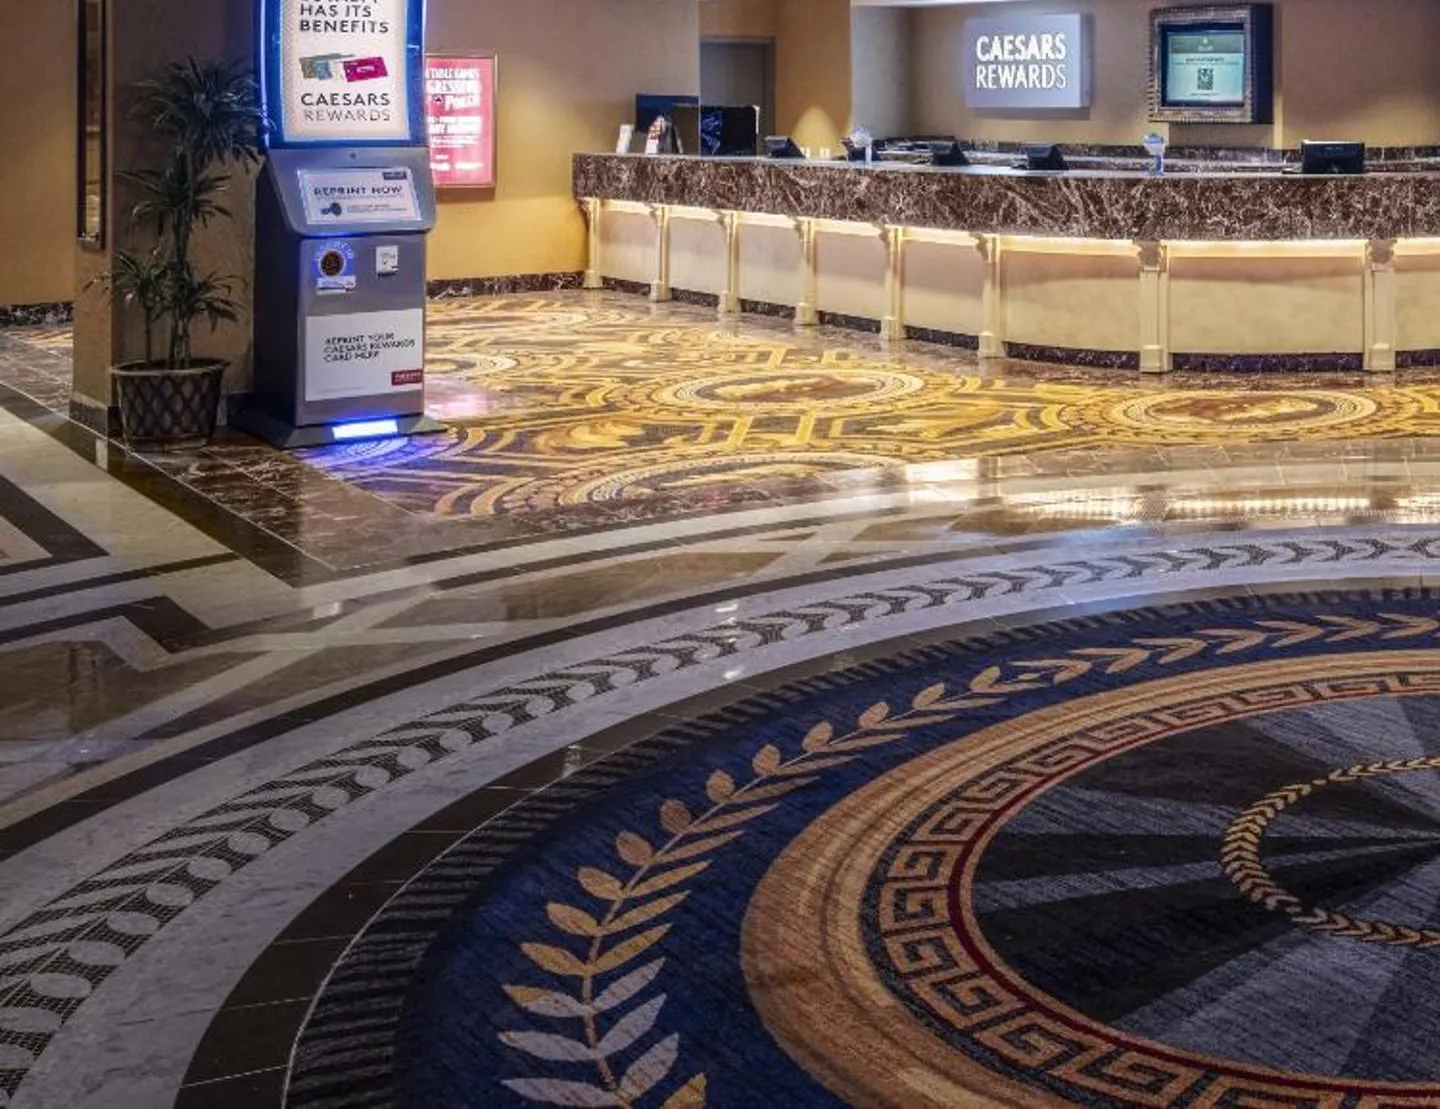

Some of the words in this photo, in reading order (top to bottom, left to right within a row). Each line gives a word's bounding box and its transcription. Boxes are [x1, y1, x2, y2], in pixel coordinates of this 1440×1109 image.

[300, 3, 338, 17] HAS
[345, 5, 372, 17] ITS
[300, 19, 390, 34] BENEFITS
[976, 34, 1066, 62] CAESARS
[976, 64, 1067, 89] REWARDS
[300, 93, 391, 106] CAESARS
[304, 108, 391, 122] REWARDS
[325, 335, 365, 346] REPRINT
[323, 343, 368, 353] CAESARS
[323, 353, 352, 363] CARD
